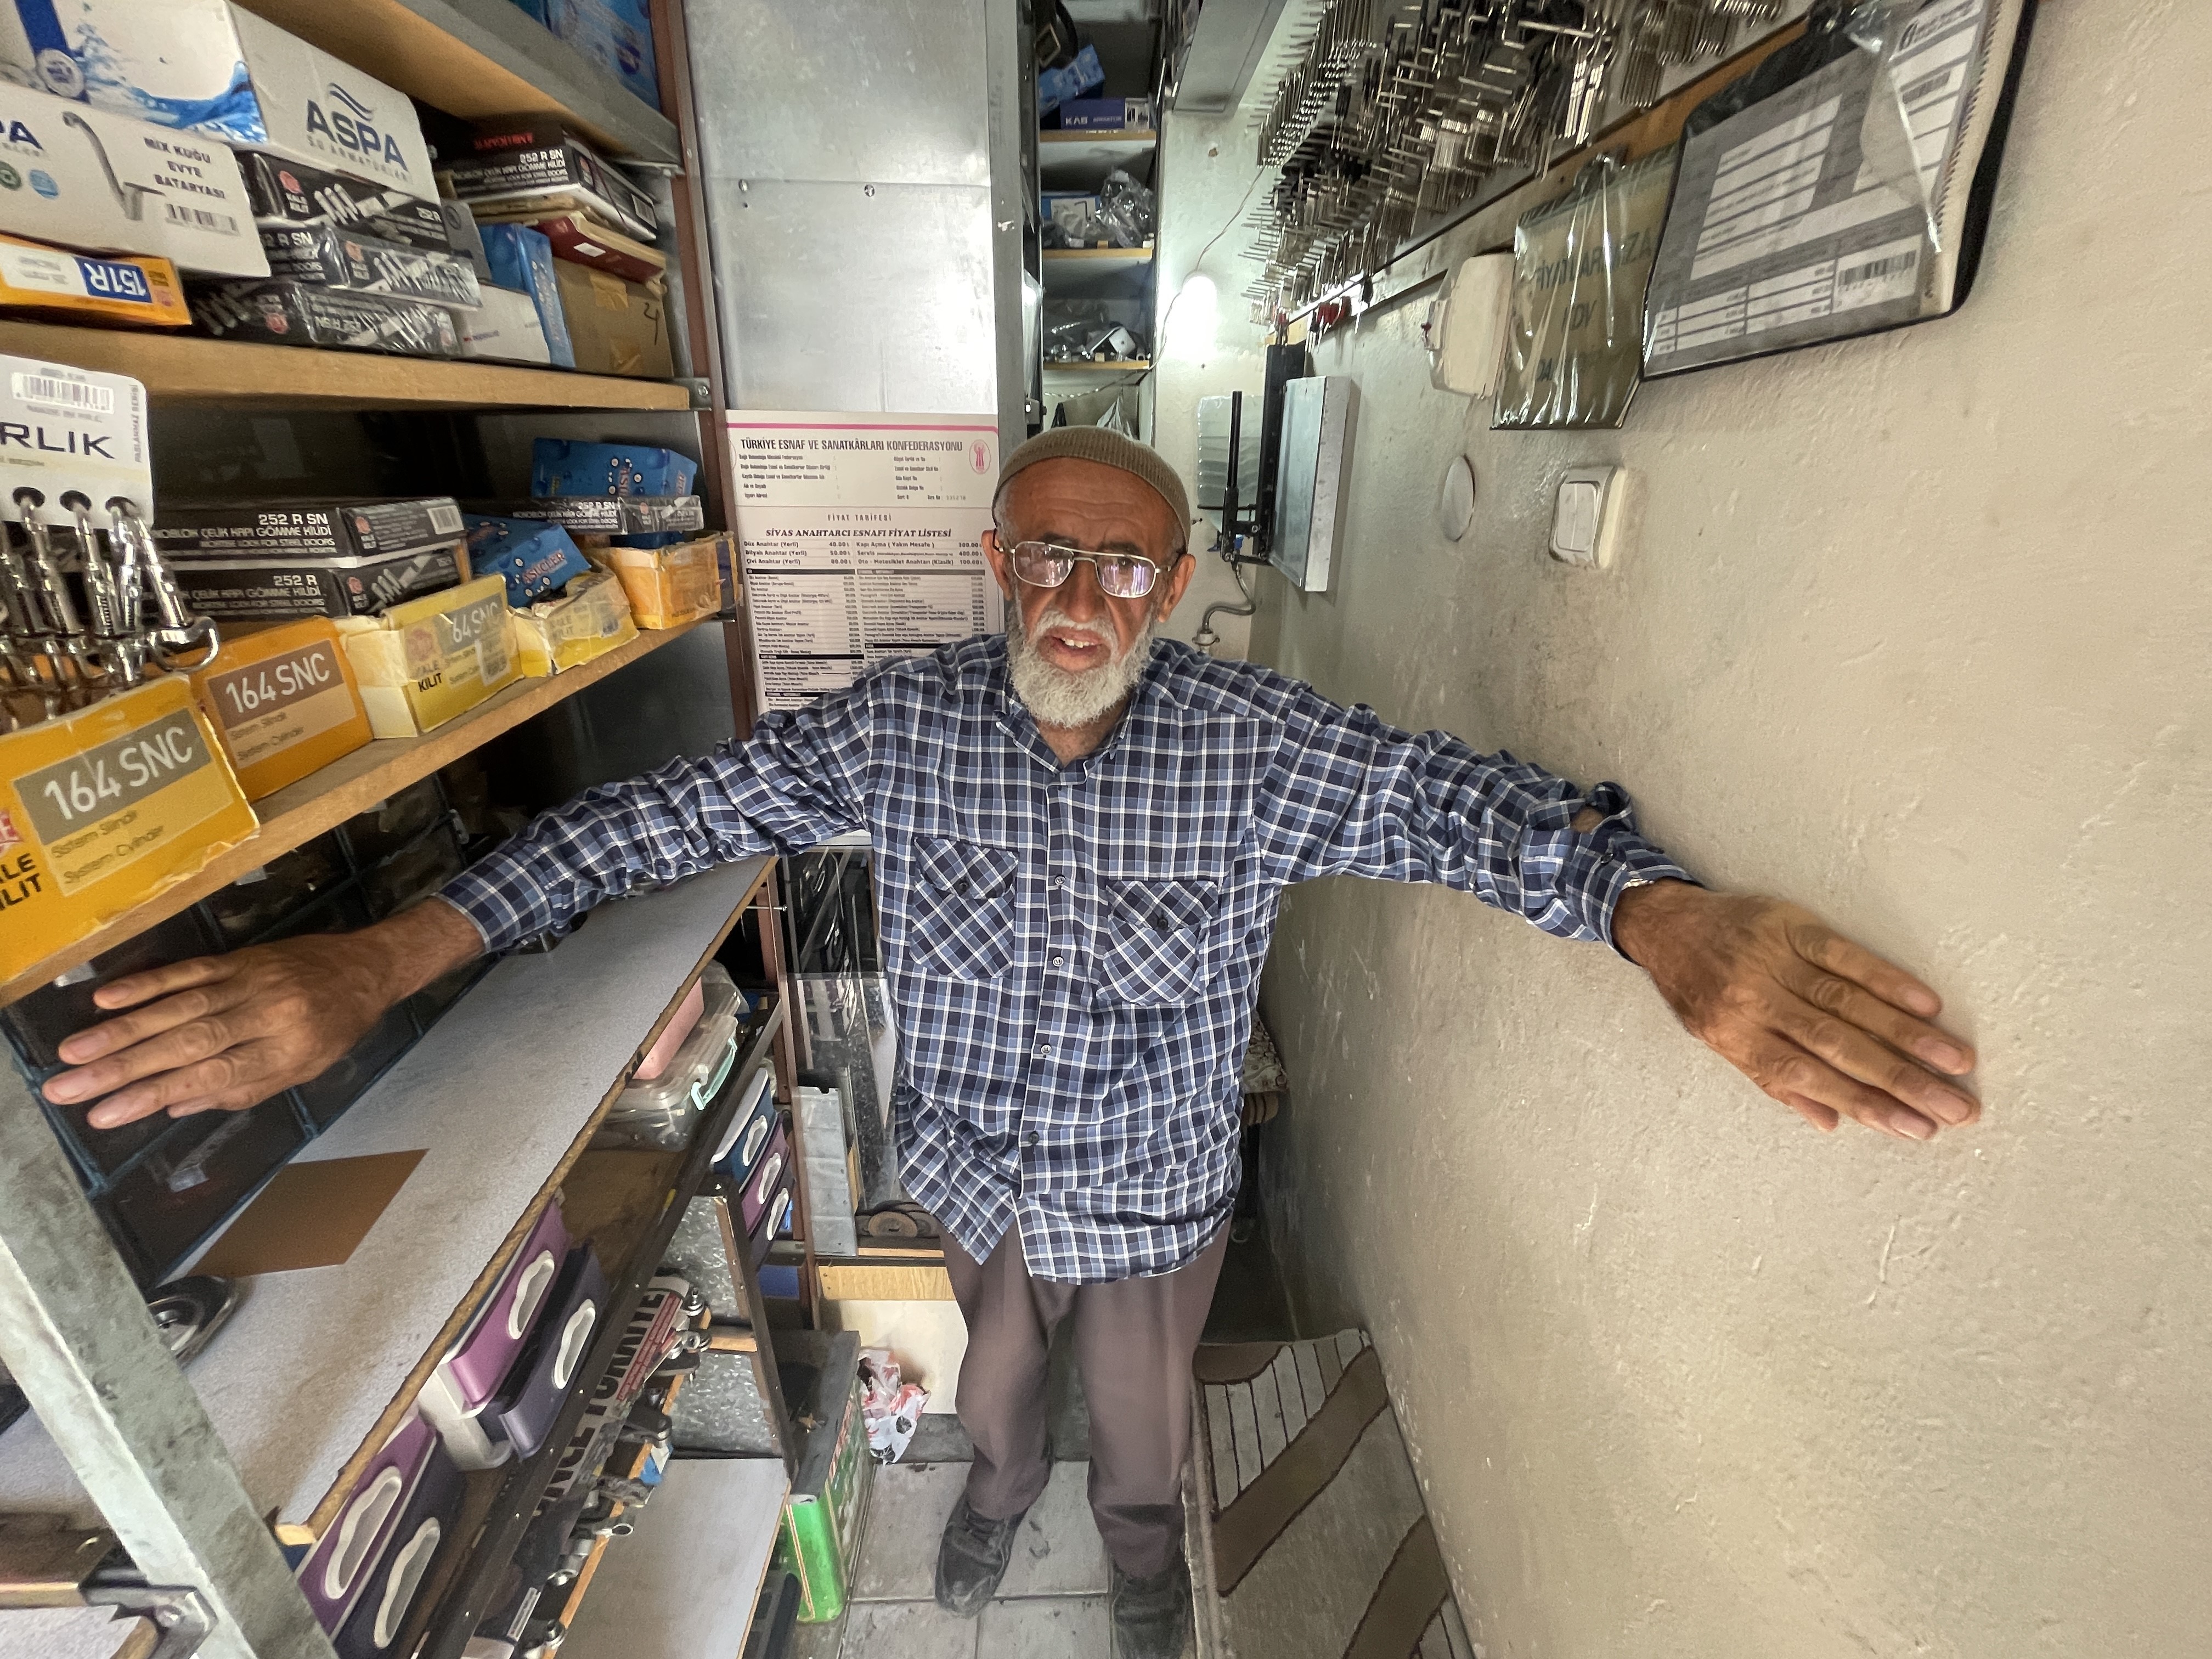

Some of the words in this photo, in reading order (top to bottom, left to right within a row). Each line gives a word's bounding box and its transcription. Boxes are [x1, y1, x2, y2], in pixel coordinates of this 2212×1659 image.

[0, 120, 43, 150] A
[307, 99, 408, 172] ASPA
[173, 146, 211, 163] KUĞU
[549, 149, 563, 160] SN
[167, 161, 202, 177] EVYE
[154, 174, 225, 199] BATARYASI
[741, 437, 776, 449] TÜRKİYE
[778, 439, 805, 449] ESNAF
[808, 440, 819, 450] VE
[822, 437, 884, 450] SANATKÂRLARI
[887, 441, 963, 451] KONFEDERASYONU
[258, 514, 289, 525] 252
[291, 514, 303, 525] R
[306, 513, 329, 525] SN
[828, 513, 850, 521] FİYAT
[256, 525, 302, 537] GÖMME
[766, 528, 793, 537] SİVAS
[888, 528, 916, 537] FİYAT
[918, 528, 952, 537] LİSTESİ
[273, 575, 303, 586] 252
[305, 574, 318, 585] R
[453, 614, 472, 643] 64
[226, 672, 276, 713] 164
[275, 653, 330, 696] SNC
[44, 760, 122, 820] 164
[119, 726, 192, 787] SNC
[0, 853, 36, 884] LE
